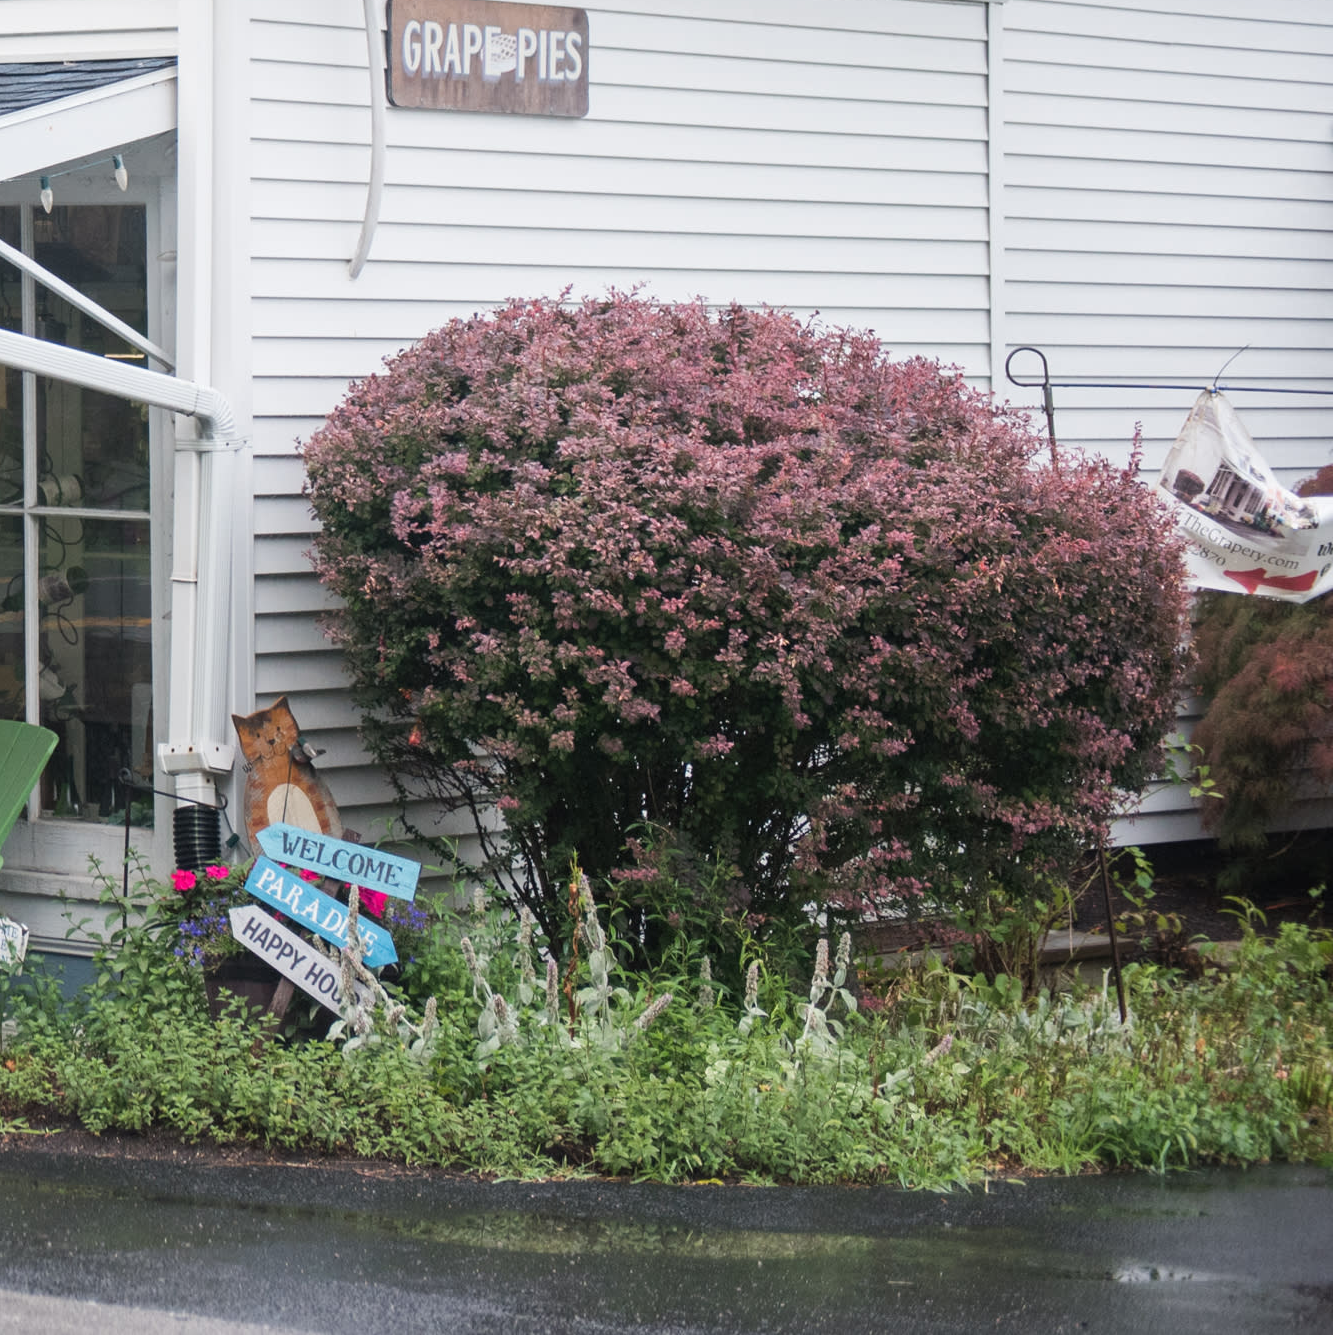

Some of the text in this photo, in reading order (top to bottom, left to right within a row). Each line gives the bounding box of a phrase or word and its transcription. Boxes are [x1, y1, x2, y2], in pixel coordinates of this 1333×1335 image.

[402, 19, 583, 82] GRAPE PIES
[282, 832, 404, 888] WELCOME
[241, 917, 308, 971] HAPPY
